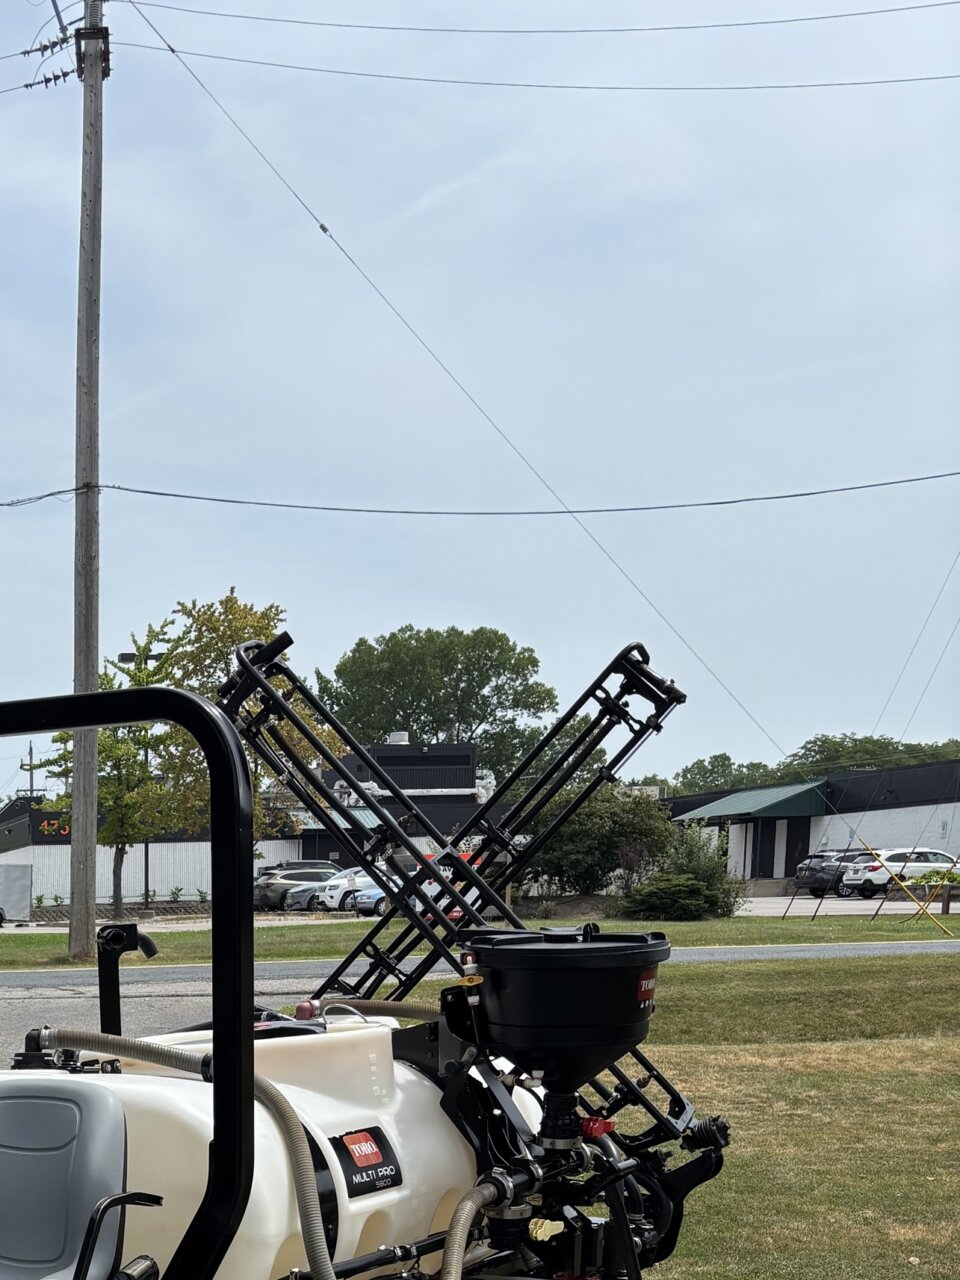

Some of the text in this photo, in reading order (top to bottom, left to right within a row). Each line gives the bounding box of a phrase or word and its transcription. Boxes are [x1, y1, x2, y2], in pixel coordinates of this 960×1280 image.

[349, 1141, 377, 1157] TORO
[352, 1165, 396, 1185] MULTI PRO
